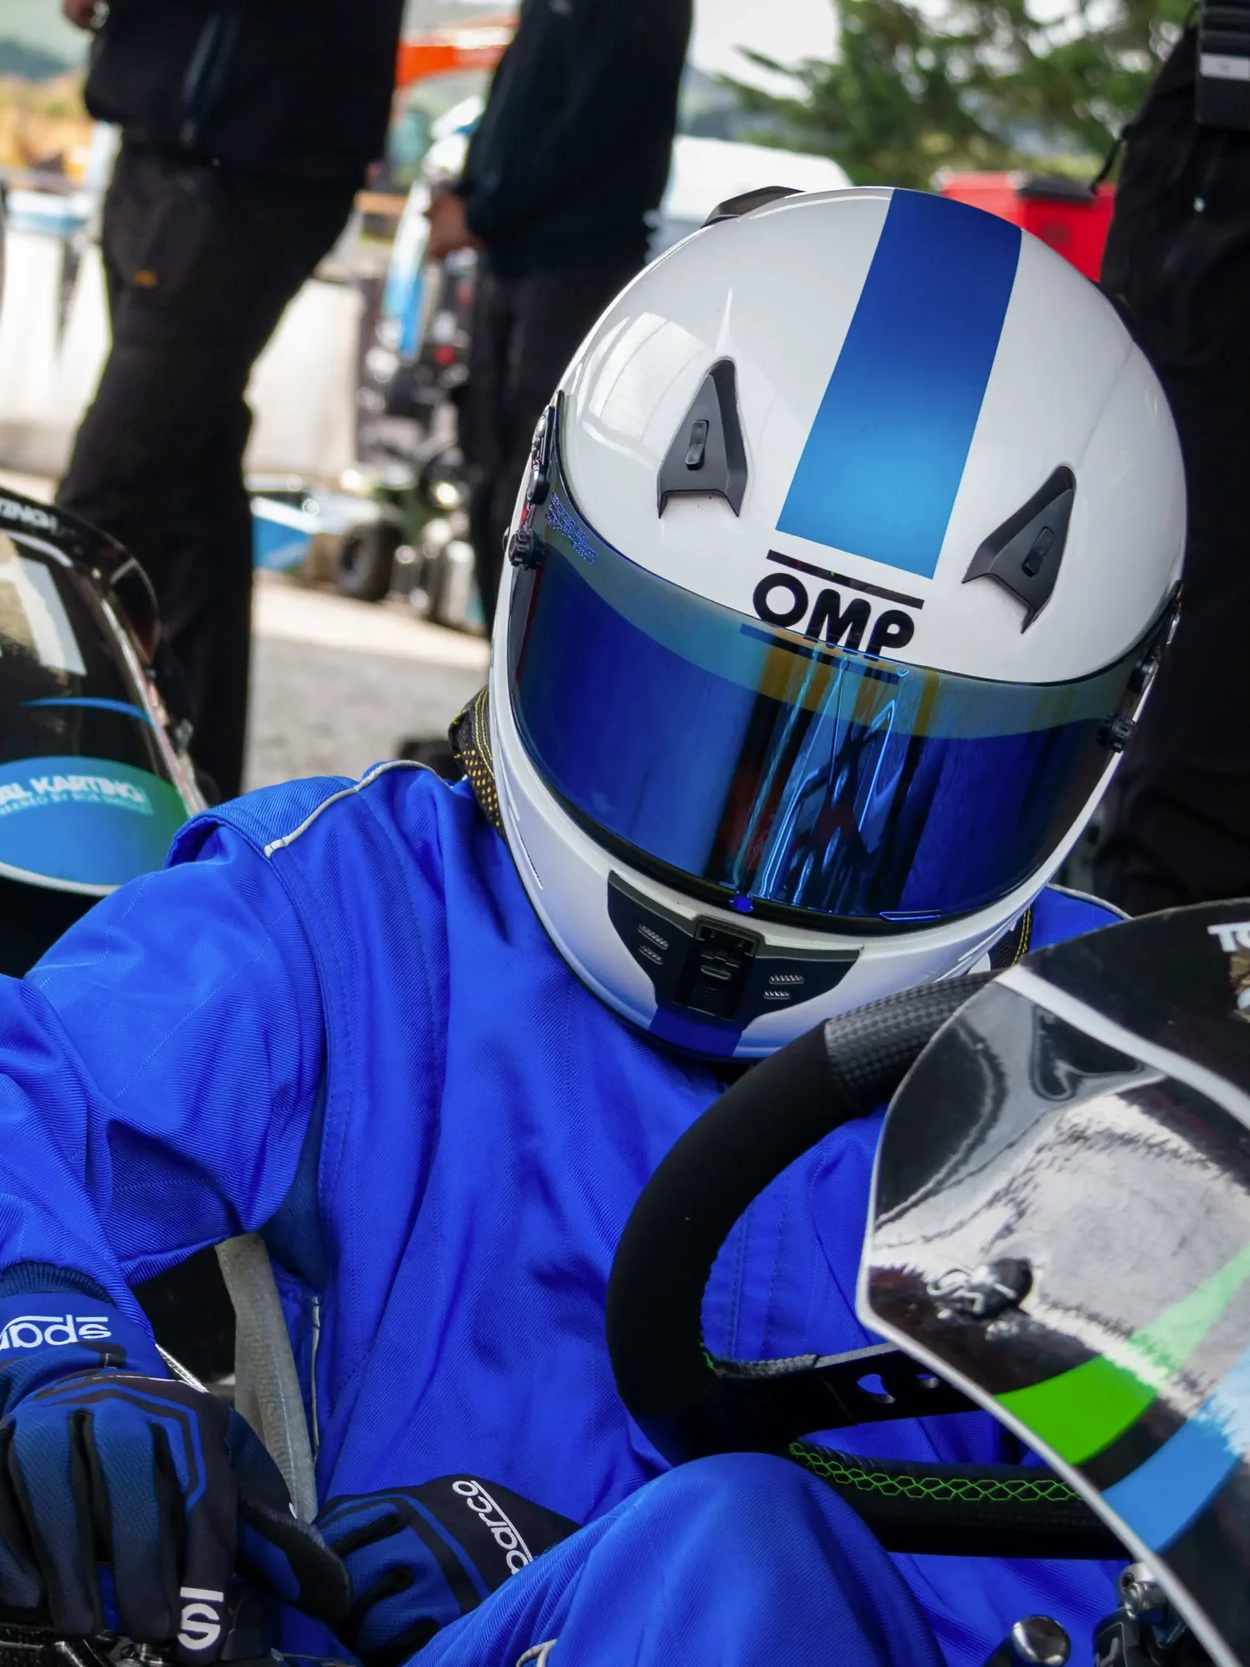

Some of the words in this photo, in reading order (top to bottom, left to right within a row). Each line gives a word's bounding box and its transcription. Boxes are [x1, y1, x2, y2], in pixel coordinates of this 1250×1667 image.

[752, 572, 915, 662] OMP
[29, 774, 148, 803] KARTING
[452, 1480, 532, 1575] parco
